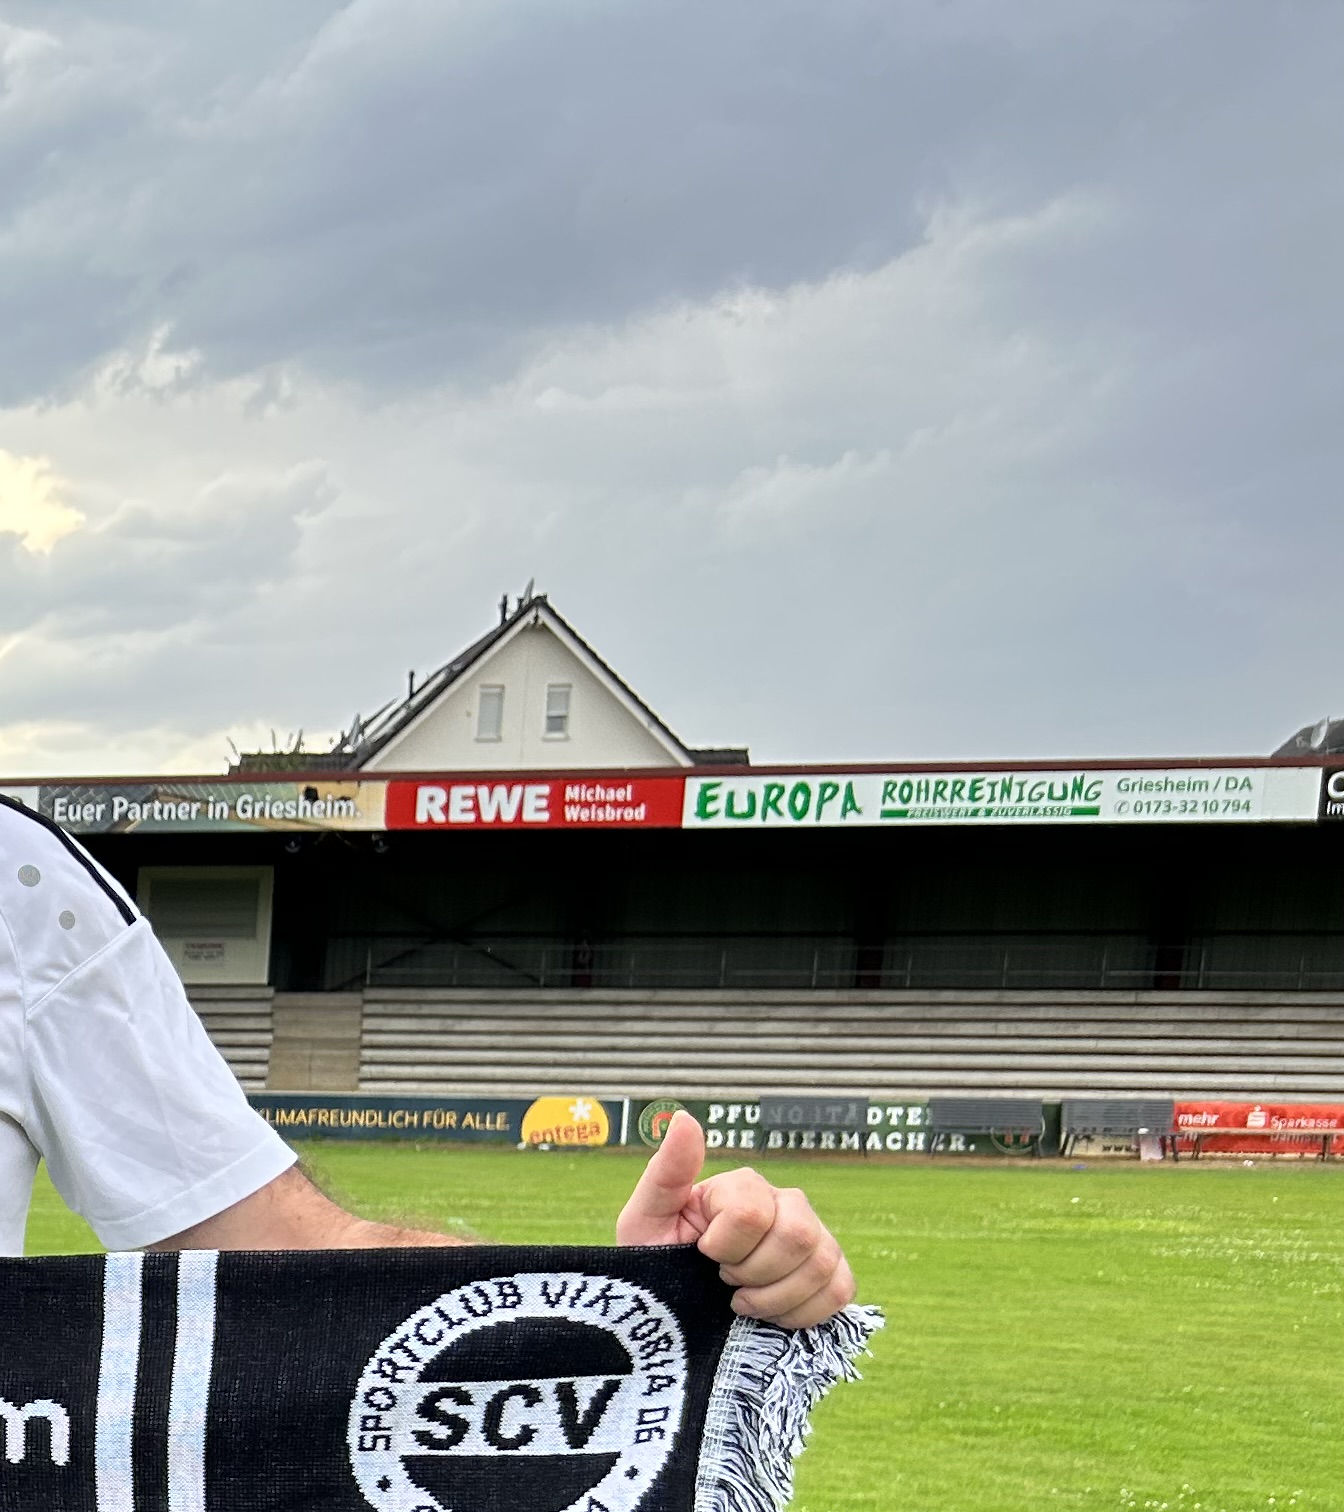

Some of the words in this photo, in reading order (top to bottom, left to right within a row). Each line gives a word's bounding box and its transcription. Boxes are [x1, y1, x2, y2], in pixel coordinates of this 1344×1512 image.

[564, 784, 633, 801] Michael
[1116, 775, 1209, 793] Griesheim
[1225, 776, 1253, 792] DA
[53, 796, 106, 822] Euer
[112, 796, 201, 822] Partner
[208, 795, 229, 820] in
[236, 793, 361, 820] Griesheim.
[415, 784, 550, 823] REWE
[695, 780, 863, 822] EUROPA
[881, 773, 1104, 805] ROHRREINIGUNG
[564, 803, 645, 822] Weisbrod
[423, 1106, 458, 1129] FÜR
[1178, 1106, 1220, 1125] mehr
[1270, 1110, 1338, 1131] Sparkasse
[706, 1129, 756, 1149] DIE
[357, 1280, 523, 1452] SPORTCLUB
[540, 1280, 677, 1396] VIKTORIA
[412, 1378, 624, 1452] SCV
